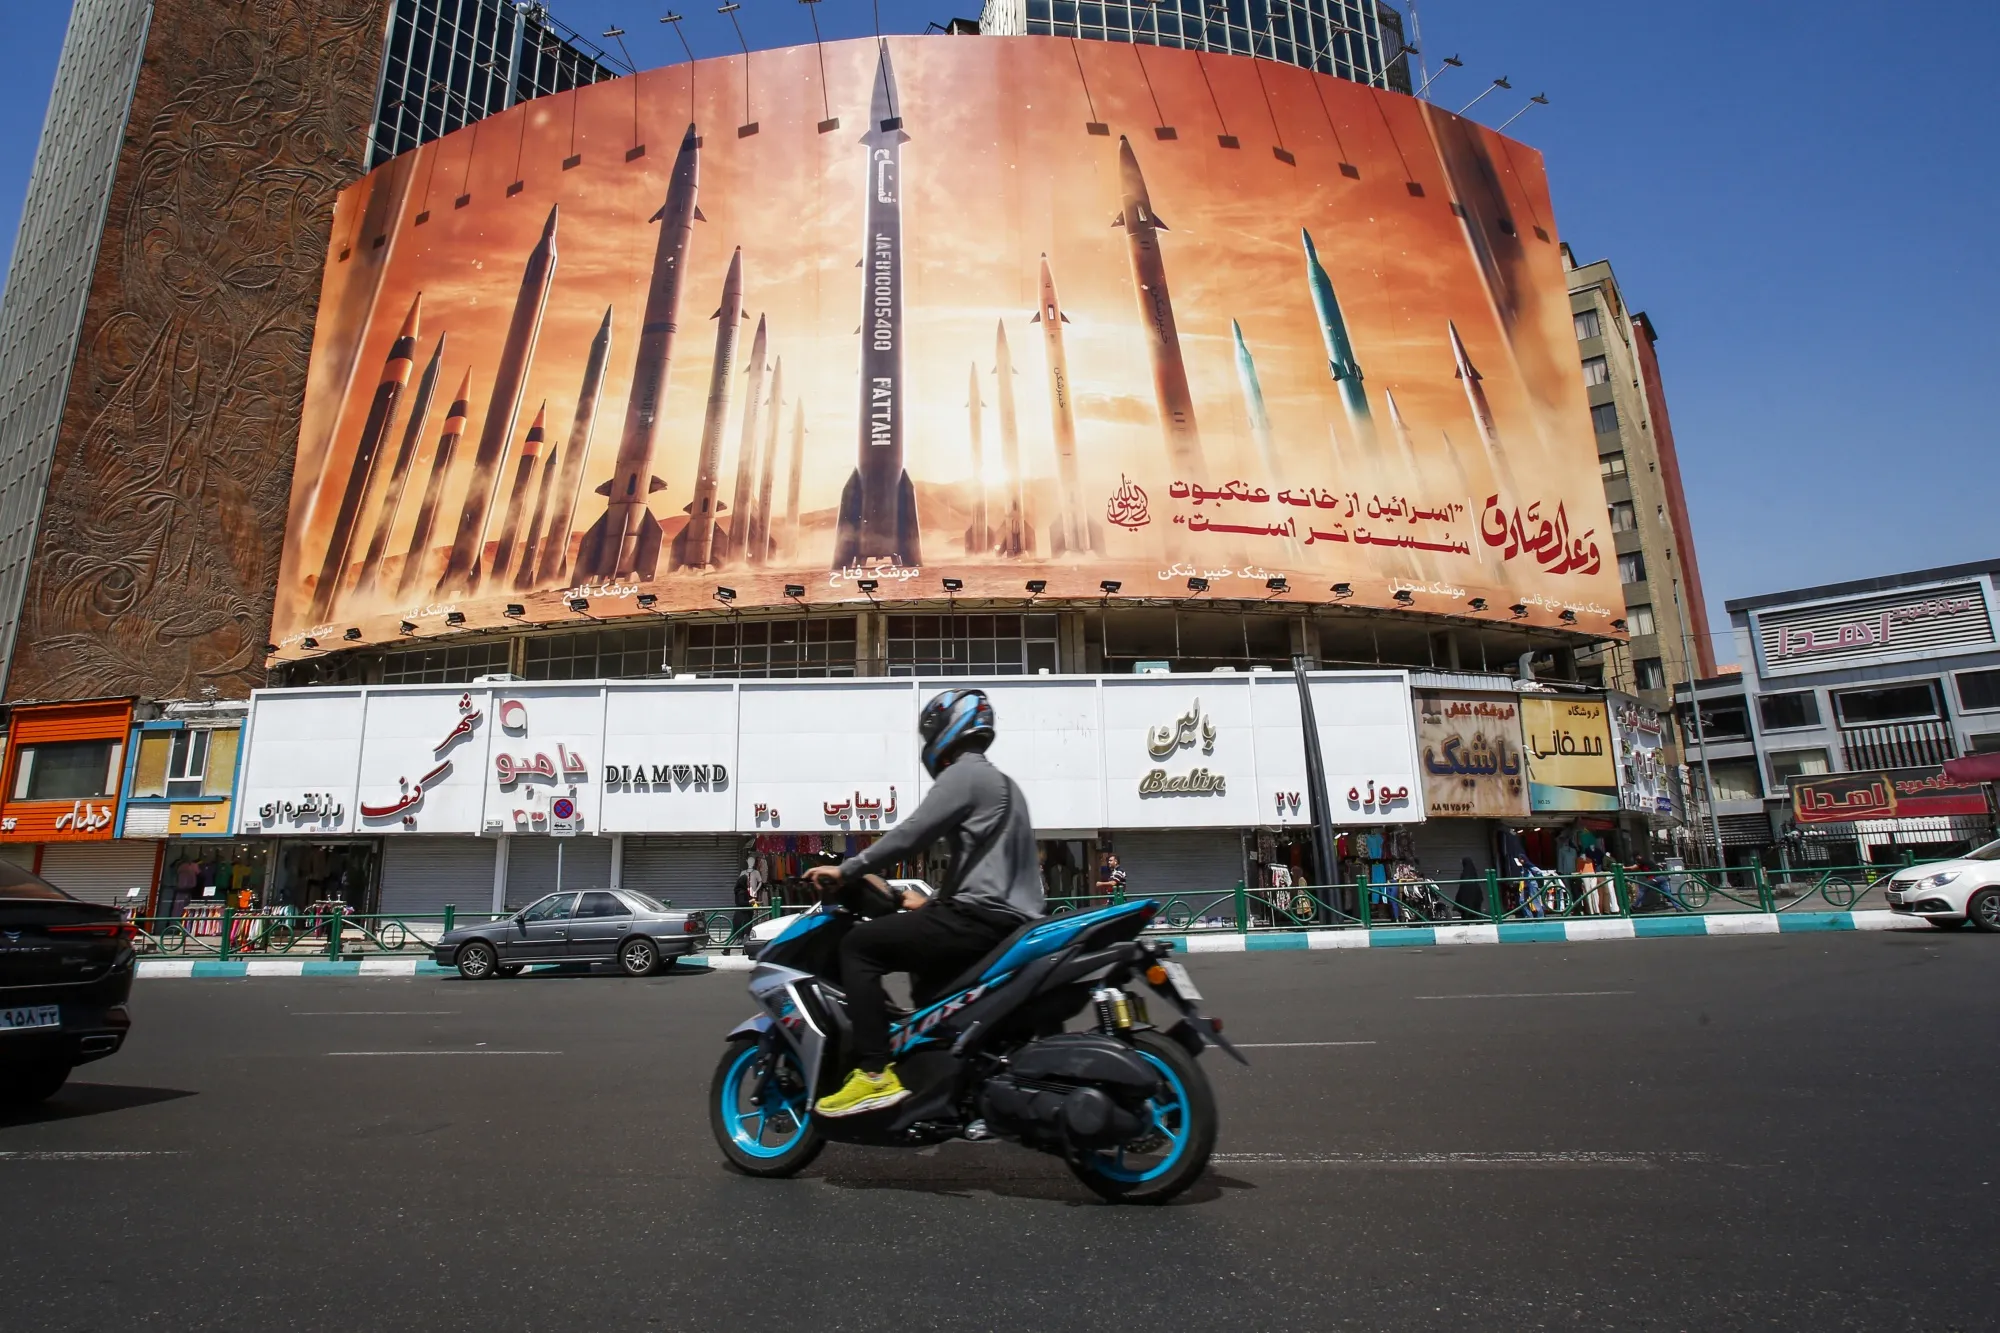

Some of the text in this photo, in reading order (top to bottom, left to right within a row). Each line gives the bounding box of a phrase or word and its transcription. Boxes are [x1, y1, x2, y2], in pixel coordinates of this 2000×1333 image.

[872, 377, 892, 446] FATTAH
[1169, 480, 1270, 507] عنکبوت
[1277, 487, 1339, 509] خانه
[1345, 492, 1360, 518] از
[1304, 523, 1349, 545] تر
[829, 564, 919, 587] موشک فتاح
[1158, 563, 1197, 580] شکن
[562, 582, 638, 606] موشک فاتح
[1429, 581, 1466, 599] موشک
[420, 603, 456, 618] موشک
[1586, 602, 1610, 617] موشک
[433, 691, 482, 752] شهر
[1444, 701, 1515, 720] فروشگاه کفش
[1568, 705, 1600, 719] فروشگاه
[1147, 697, 1216, 756] بالین
[360, 759, 452, 826] کیف
[1138, 767, 1227, 795] Balin
[1348, 780, 1409, 805] موزه
[823, 785, 897, 821] زیبایی
[1275, 791, 1300, 808] ۲۷
